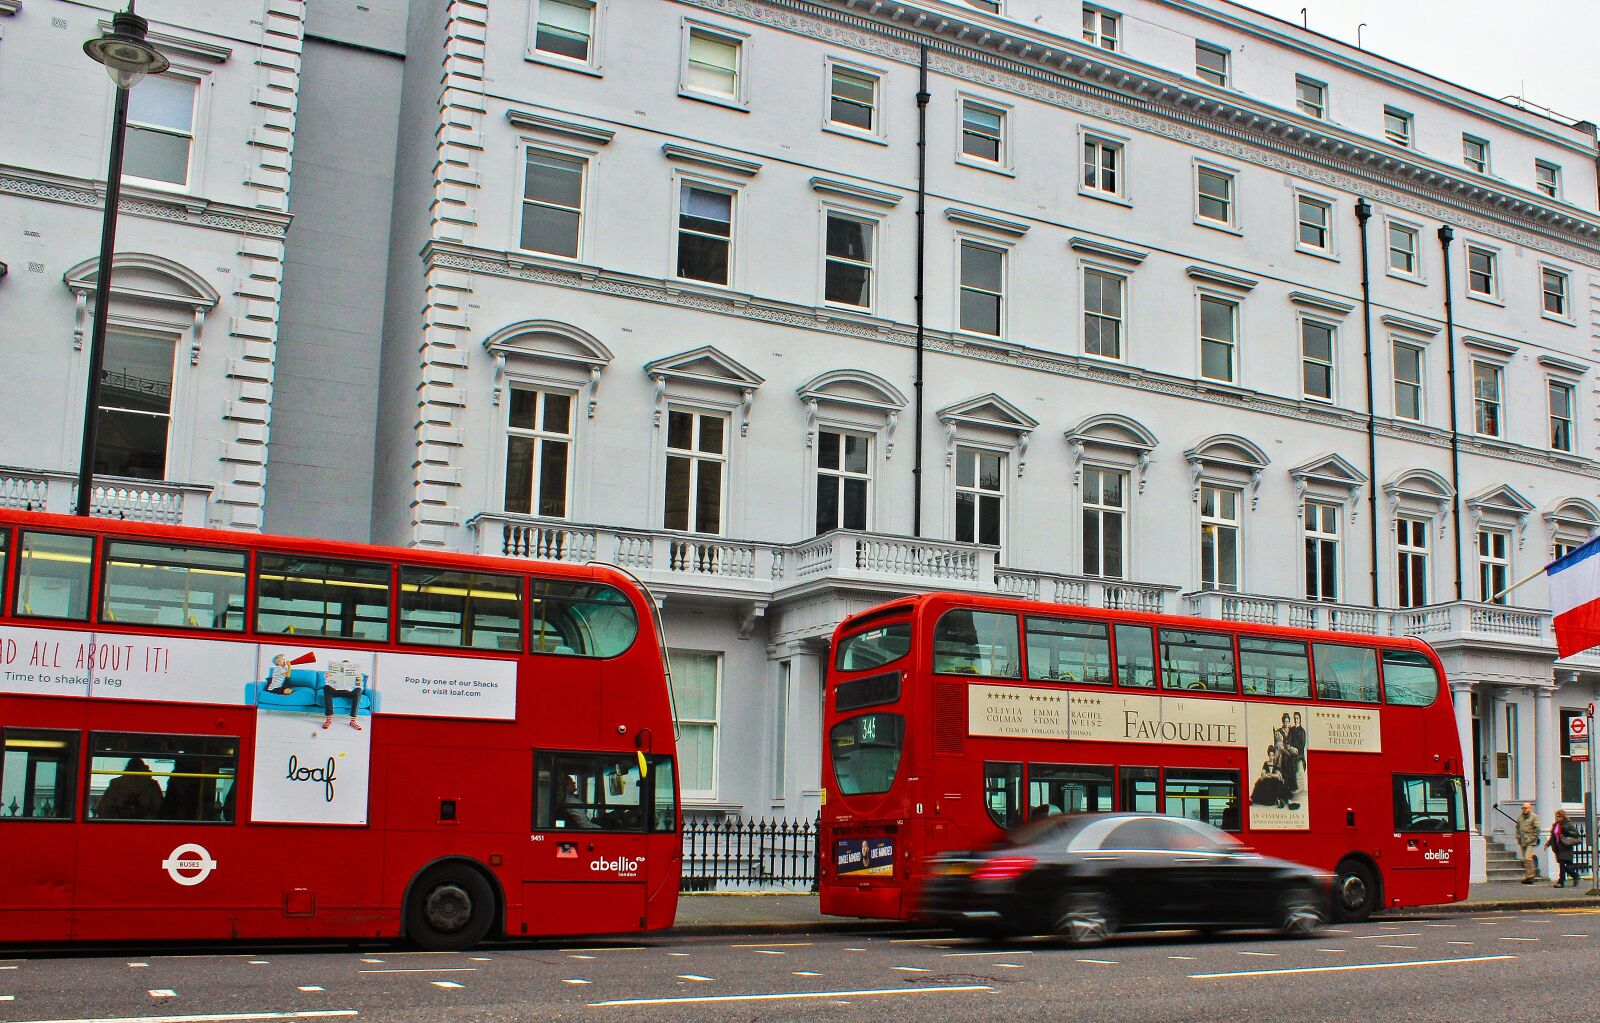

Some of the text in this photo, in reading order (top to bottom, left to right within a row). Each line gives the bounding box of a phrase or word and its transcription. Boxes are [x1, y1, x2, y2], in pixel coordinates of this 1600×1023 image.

[29, 641, 61, 668] ALL
[75, 643, 134, 671] ABOUT
[145, 646, 169, 674] IT!
[4, 671, 122, 688] Time to shake a leg
[405, 677, 420, 685] Pop
[422, 677, 432, 686] by
[433, 678, 448, 686] one
[432, 688, 448, 696] visit
[450, 689, 481, 697] loaf.com
[986, 706, 1102, 720] OLIVIA EMMA RACHEL
[986, 714, 1102, 728] COLMAN STONE WEISZ
[1122, 710, 1238, 743] FAVOURITE
[862, 717, 876, 740] 345
[1005, 726, 1020, 734] FILM
[1328, 730, 1361, 739] BRILLIANT
[286, 754, 337, 802] loaf
[1425, 849, 1450, 860] abellio
[179, 861, 200, 869] BUSES
[590, 856, 638, 872] abellio
